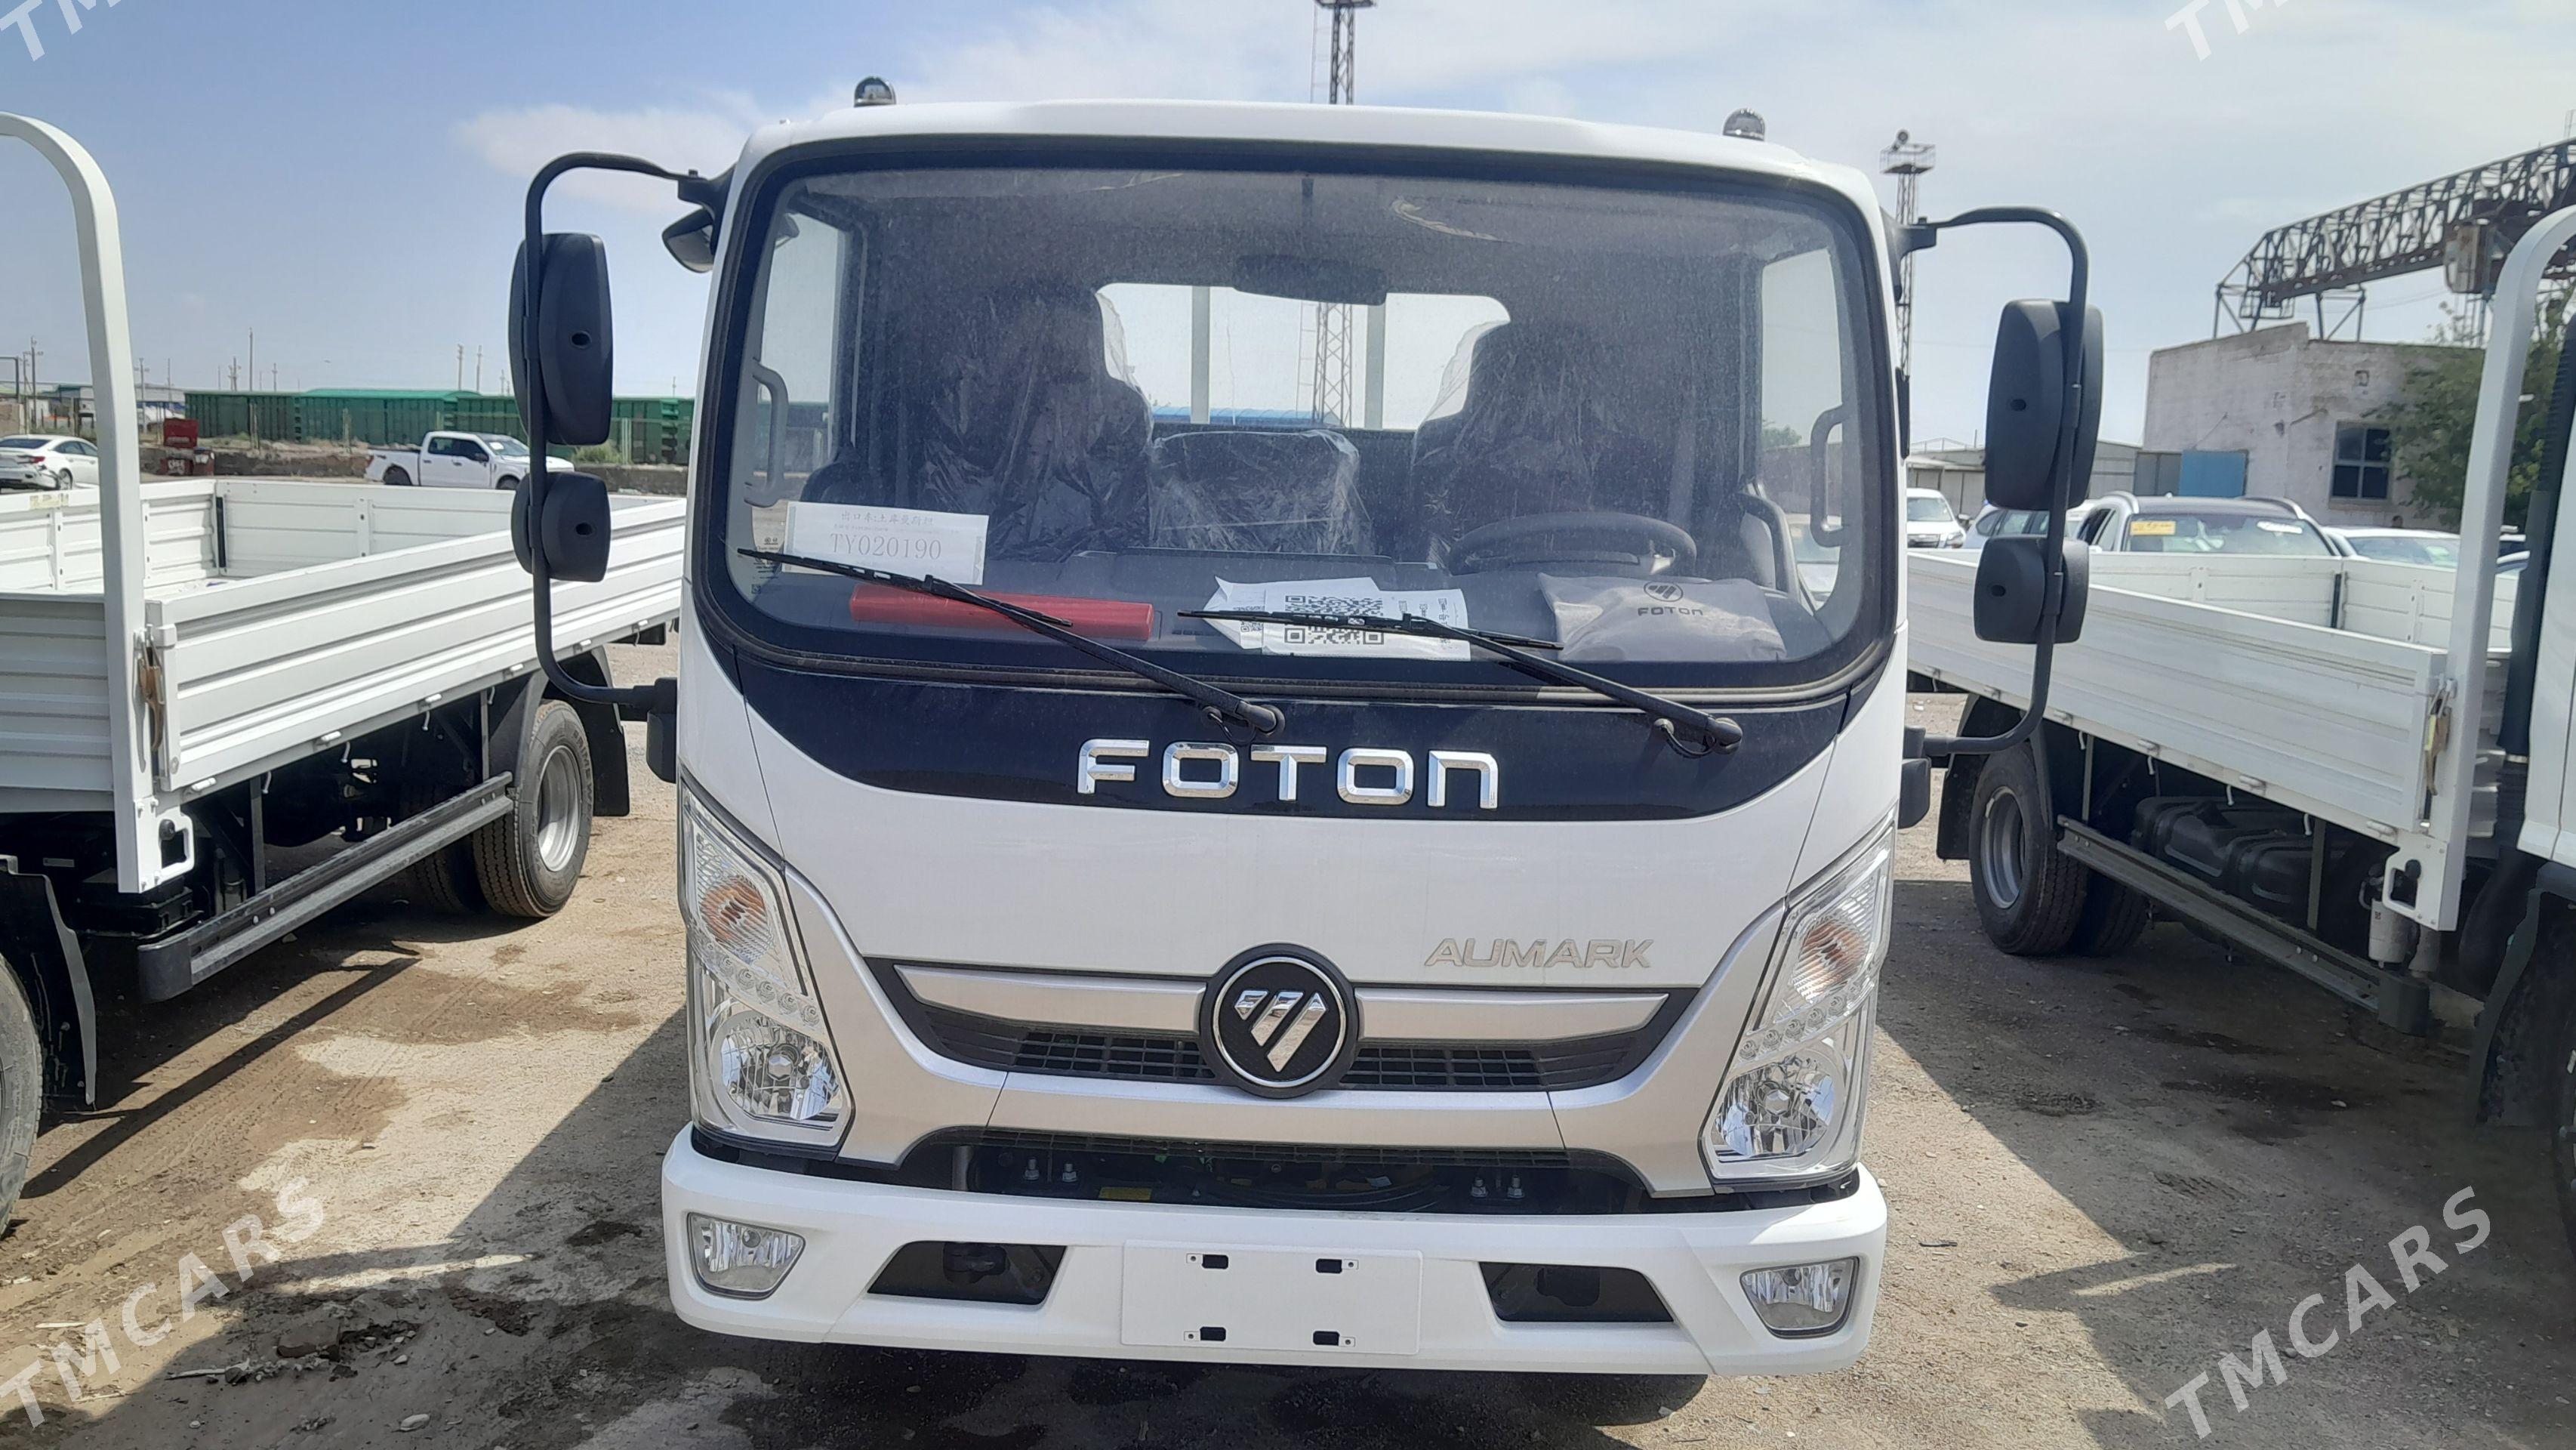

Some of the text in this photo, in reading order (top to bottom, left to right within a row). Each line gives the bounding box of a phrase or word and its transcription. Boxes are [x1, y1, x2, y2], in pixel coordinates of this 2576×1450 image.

[830, 532, 941, 560] TY020190
[1637, 606, 1704, 616] FOTON
[1077, 739, 1499, 810] FOTON
[1424, 938, 1654, 968] AUMARK
